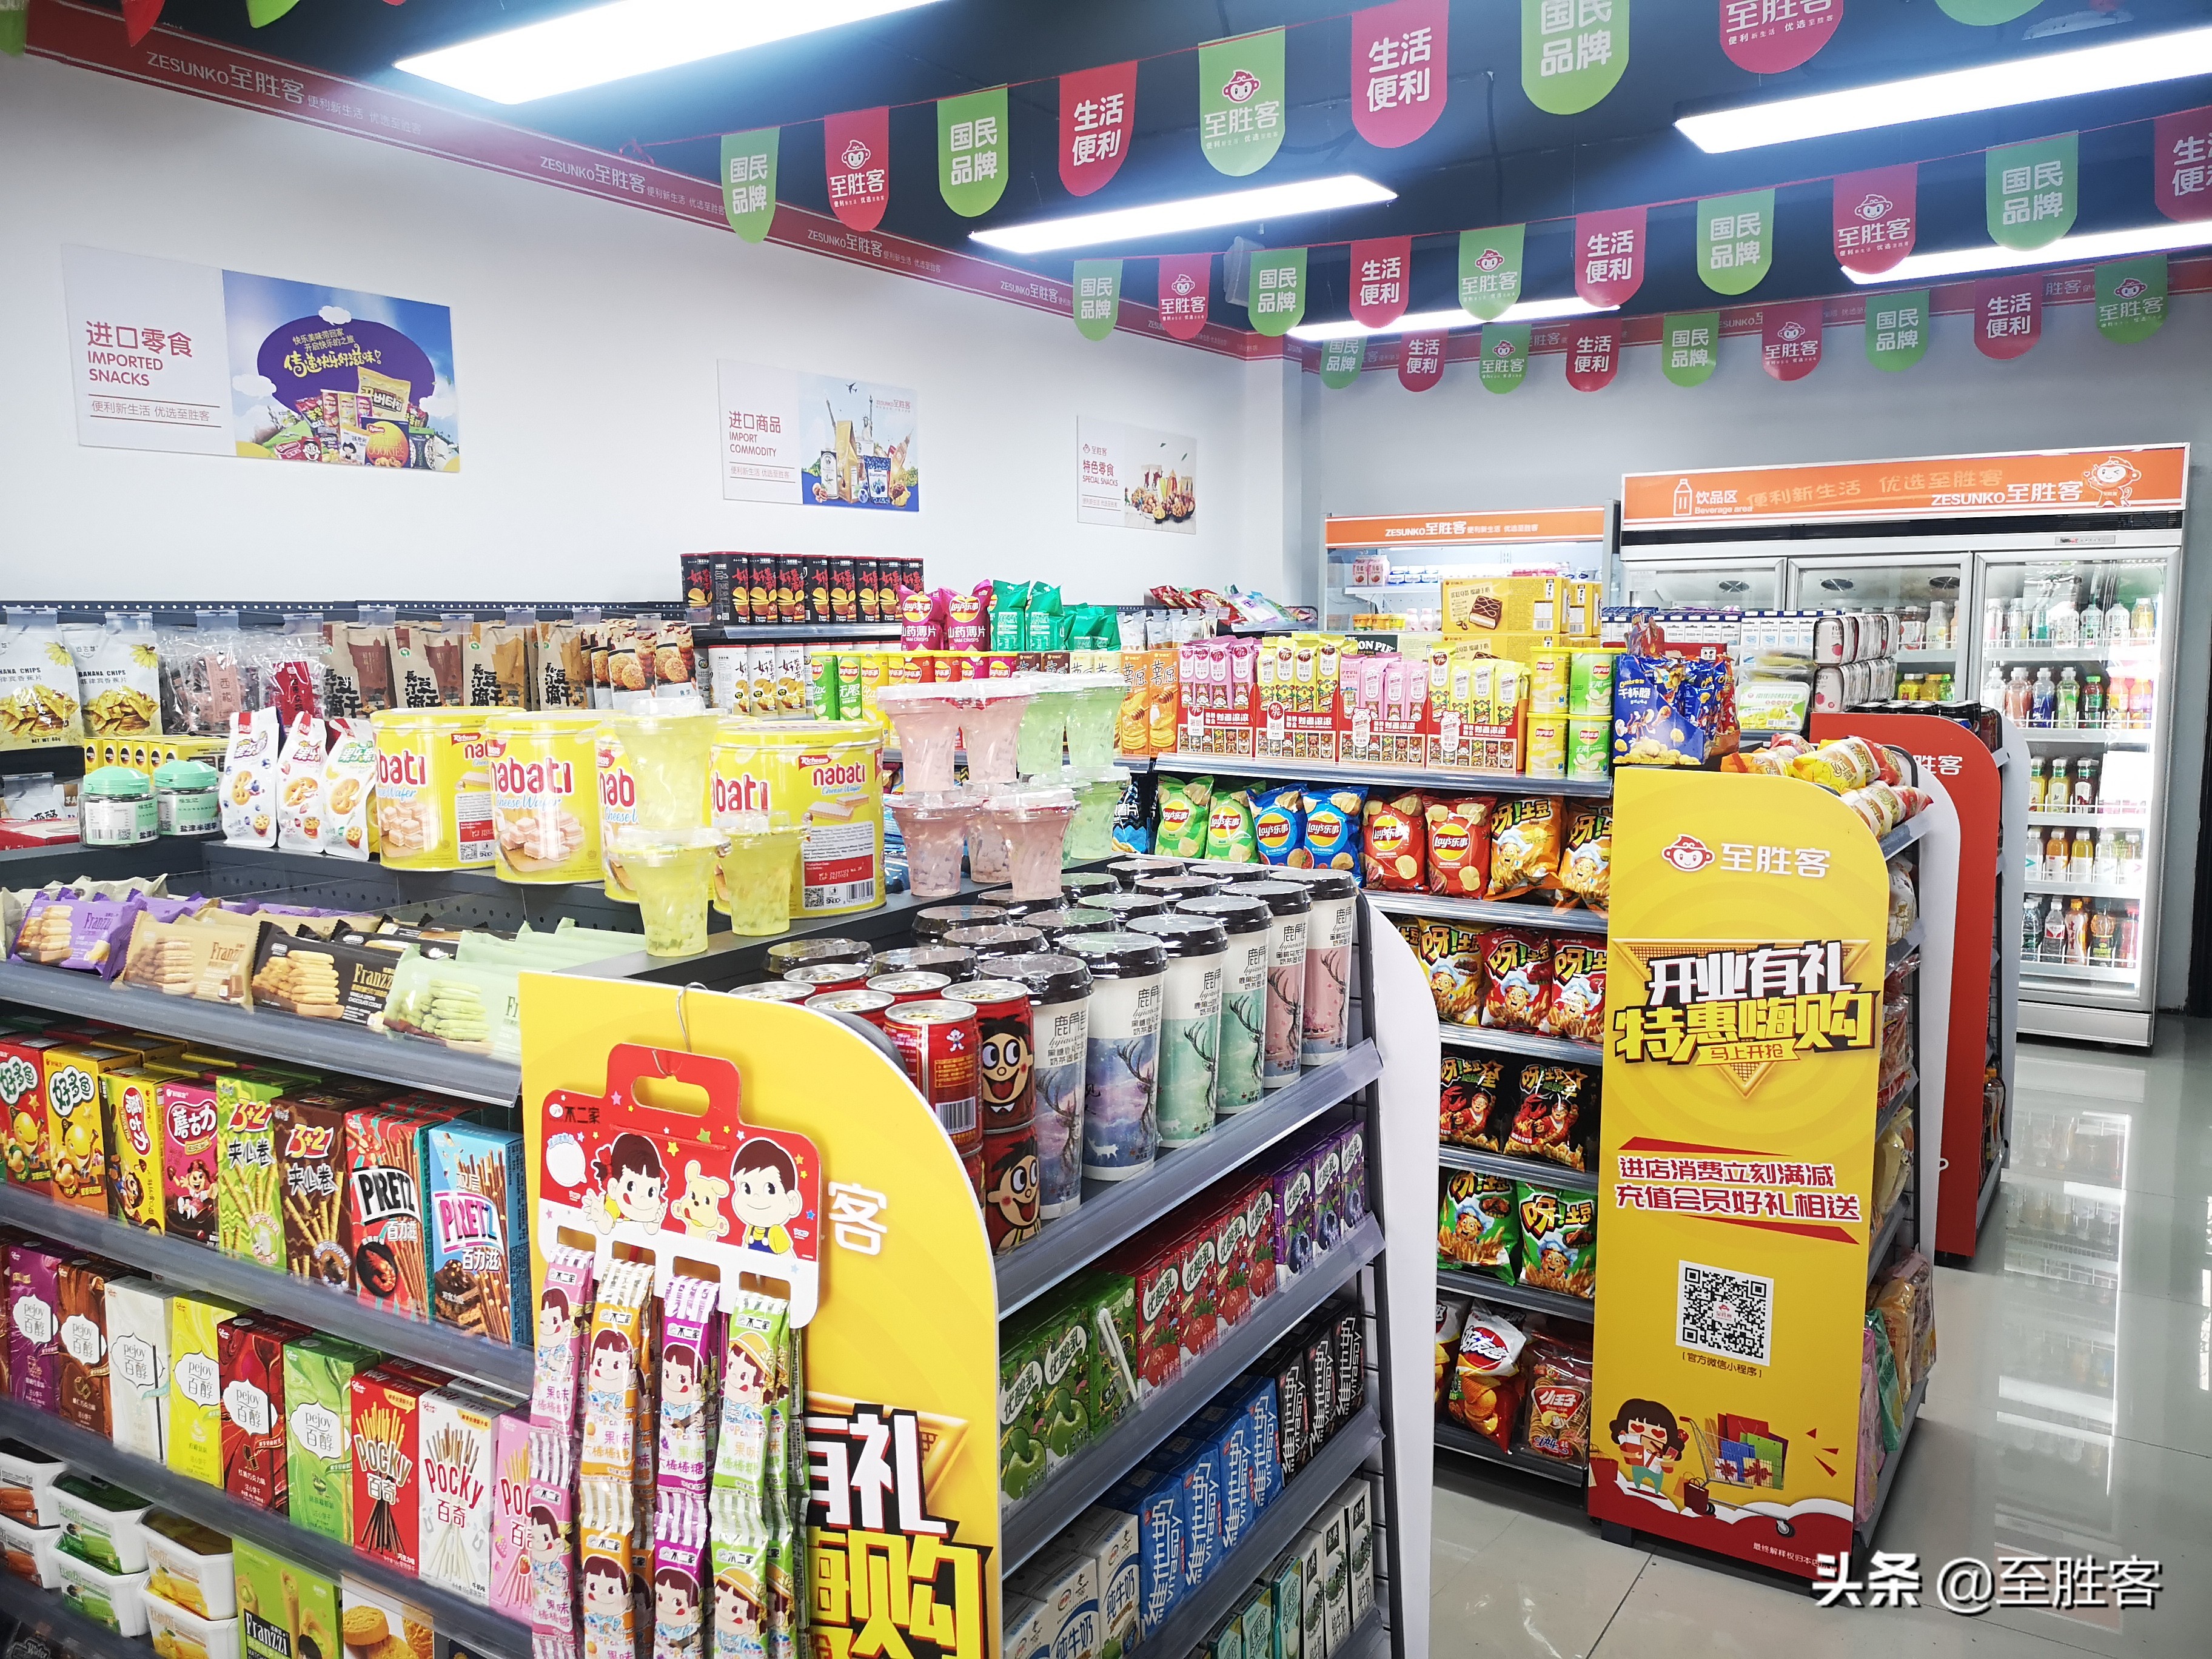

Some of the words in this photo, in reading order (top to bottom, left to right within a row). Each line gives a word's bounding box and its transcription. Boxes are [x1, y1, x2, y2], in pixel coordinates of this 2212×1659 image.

[1541, 0, 1611, 35] 国民
[1369, 27, 1432, 73] 生活
[1540, 29, 1612, 77] 品牌
[147, 51, 229, 85] ZESUNKO
[229, 64, 305, 105] 至胜客
[1367, 67, 1431, 113] 便利
[1074, 93, 1124, 132] 生活
[1204, 101, 1279, 139] 至胜客
[950, 116, 998, 152] 国民
[1072, 129, 1120, 166] 便利
[541, 156, 595, 181] ZESUNKO
[595, 164, 645, 195] 至胜客
[646, 186, 685, 204] 便利新生活
[730, 154, 768, 183] 国民
[951, 151, 998, 186] 品牌
[2002, 161, 2063, 195] 国民
[830, 169, 885, 198] 至胜客
[732, 186, 767, 215] 品牌
[2003, 193, 2063, 225] 品牌
[1711, 212, 1761, 241] 国民
[1838, 218, 1911, 249] 至胜客
[808, 229, 846, 249] ZESUNKO
[846, 234, 882, 257] 至胜客
[1587, 230, 1634, 258] 生活
[1711, 241, 1760, 270] 品牌
[1259, 267, 1297, 290] 国民
[1361, 257, 1401, 281] 生活
[1586, 257, 1632, 284] 便利
[1000, 281, 1030, 297] ZESUNKO
[1030, 284, 1059, 303] 至胜客
[1081, 277, 1113, 298] 国民
[1359, 282, 1399, 306] 便利
[1461, 272, 1518, 295] 至胜客
[1081, 300, 1111, 320] 品牌
[1161, 296, 1205, 315] 至胜客
[1258, 292, 1296, 313] 品牌
[1987, 292, 2031, 318] 生活
[2099, 297, 2164, 323] 至胜客
[1876, 307, 1919, 330] 国民
[1986, 315, 2031, 339] 便利
[86, 321, 193, 358] 进口零食
[292, 327, 344, 346] 快乐美味带回家
[1409, 339, 1440, 356] 生活
[1577, 335, 1611, 354] 生活
[1672, 328, 1709, 347] 国民
[1876, 329, 1919, 352] 品牌
[87, 350, 163, 371] IMPORTED
[1672, 349, 1708, 368] 品牌
[1765, 341, 1818, 360] 至胜客
[1406, 357, 1437, 374] 便利
[1482, 357, 1524, 373] 至胜客
[1575, 355, 1609, 373] 便利
[89, 368, 150, 387] SNACKS
[91, 400, 151, 417] 便利新生活
[154, 406, 210, 421] 优选至胜客
[729, 411, 781, 434] 进口商品
[729, 431, 757, 443] IMPORT
[729, 444, 777, 457] COMMODITY
[731, 466, 760, 476] 便利新生活
[762, 469, 789, 479] 优选至胜客
[1083, 459, 1114, 477] 特色零食
[1082, 475, 1100, 484] SPECIAL
[1101, 477, 1118, 486] SNACKS
[1746, 479, 1862, 509] 便利新生活
[1879, 469, 2003, 494] 优选至胜客
[1695, 489, 1738, 505] 饮品区
[1931, 492, 2006, 507] ZESUNKO
[2006, 480, 2085, 504] 至胜客
[1694, 506, 1733, 515] Beverage
[1385, 527, 1426, 537] ZESUNKO
[1426, 521, 1467, 535] 至胜客
[948, 625, 986, 638] 山药薄片
[1150, 660, 1176, 686] 薯愿
[839, 684, 860, 699] 无限
[1618, 686, 1651, 700] 千杯脆
[813, 762, 866, 786] nabati
[386, 788, 417, 799] Wafer
[496, 796, 523, 808] Cheese
[523, 797, 561, 809] Wafer
[822, 786, 843, 795] Cheese
[1258, 826, 1274, 836] Lay's
[1273, 824, 1289, 834] 乐事
[1307, 823, 1324, 834] Lay's
[1324, 822, 1341, 833] 乐事
[1491, 800, 1550, 839] 呀!土豆
[1434, 836, 1452, 847] Lay's
[1452, 836, 1470, 848] 乐事
[1720, 842, 1831, 879] 至胜客
[84, 912, 112, 931] Franzzi
[1490, 940, 1549, 978] 呀!土豆
[354, 963, 394, 990] Franzz
[1649, 942, 1856, 1006] 开业有礼
[1615, 991, 1875, 1063] 特惠嗨购
[1710, 1042, 1784, 1061] 马上开抢
[0, 1061, 35, 1103] 好多鱼
[52, 1071, 93, 1110] 好多鱼
[125, 1090, 150, 1154] 蘑古力
[172, 1107, 216, 1139] 蘑古力
[229, 1098, 267, 1133] 3+2
[565, 1106, 600, 1124] 不二家
[228, 1138, 275, 1168] 夹心卷
[288, 1124, 327, 1158] 3+2
[1344, 1137, 1361, 1170] 优酸乳
[287, 1163, 337, 1195] 夹心卷
[456, 1171, 480, 1192] 双层
[1316, 1156, 1336, 1191] 优酸乳
[1617, 1156, 1835, 1188] 进店消费立刻满减
[358, 1170, 416, 1215] PRETZ
[1286, 1176, 1307, 1212] 优酸乳
[1615, 1184, 1862, 1222] 充值会员好礼相送
[438, 1198, 497, 1242] PRETZ
[828, 1182, 889, 1256] 客
[1521, 1196, 1593, 1239] 呀!土豆
[387, 1220, 418, 1242] 百力滋
[461, 1248, 501, 1271] 百力滋
[24, 1318, 45, 1336] 百醇
[73, 1341, 93, 1358] 百醇
[125, 1359, 148, 1379] 百醇
[188, 1361, 213, 1378] pejoy
[188, 1376, 213, 1399] 百醇
[236, 1387, 261, 1405] pejoy
[546, 1386, 569, 1403] 果味
[1540, 1390, 1577, 1407] 小王子
[237, 1406, 262, 1427] 百醇
[305, 1411, 332, 1430] pejoy
[306, 1430, 333, 1452] 百醇
[605, 1430, 631, 1446] 果味
[354, 1434, 412, 1487] Pocky
[583, 1445, 629, 1459] 大棒棒糖
[678, 1445, 705, 1460] 果味
[659, 1456, 705, 1475] 大棒棒糖
[367, 1473, 397, 1505] 百奇
[425, 1458, 483, 1509] Pocky
[1222, 1429, 1244, 1548] 維他奶
[1239, 1446, 1252, 1527] vitasoy
[437, 1499, 466, 1528] 百奇
[1185, 1462, 1211, 1586] 維他奶
[1205, 1480, 1219, 1563] vitasoy
[670, 1552, 696, 1564] 不二家
[728, 1552, 754, 1564] 不二家
[1106, 1570, 1136, 1620] 纯牛奶
[246, 1612, 287, 1655] Franzzi
